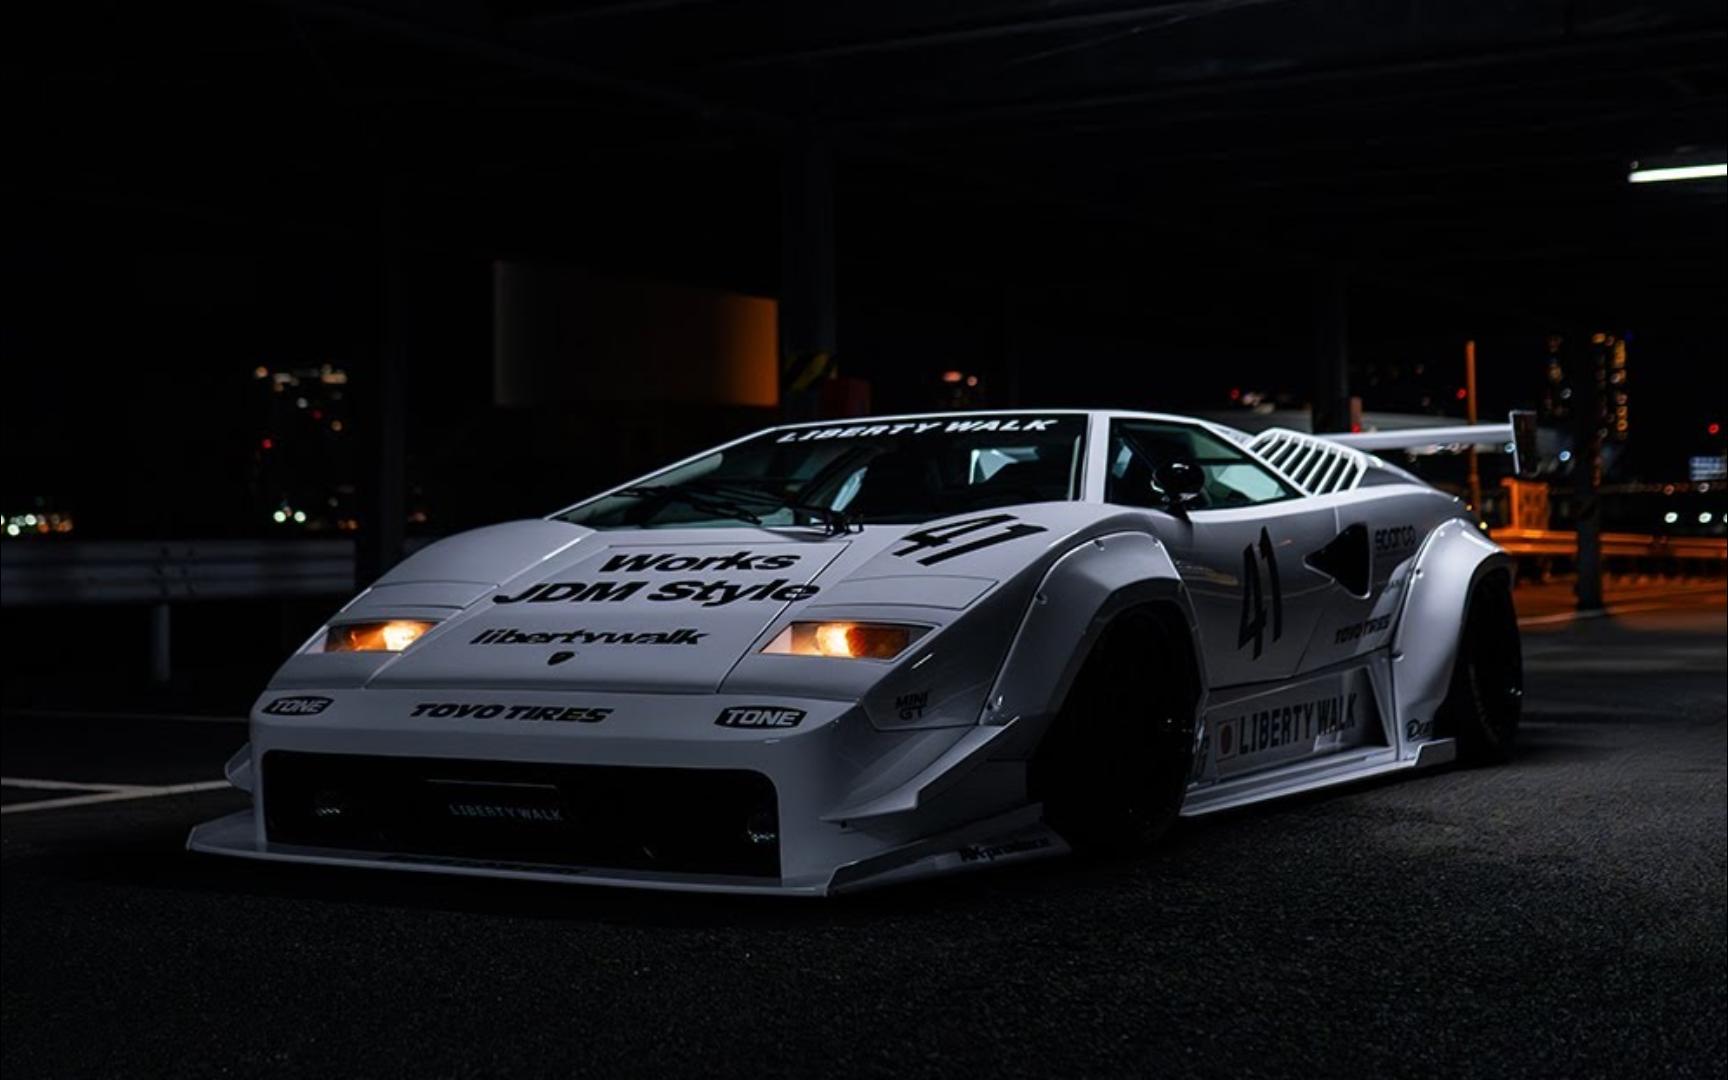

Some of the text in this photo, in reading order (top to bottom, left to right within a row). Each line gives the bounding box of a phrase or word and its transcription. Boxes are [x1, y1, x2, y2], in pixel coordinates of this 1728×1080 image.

[776, 418, 1059, 444] LIBERTY WALK
[893, 514, 1048, 566] 41
[599, 551, 801, 573] Works
[493, 579, 821, 607] JDM Style
[1238, 526, 1282, 661] 41
[470, 629, 709, 645] libertywalk
[270, 699, 330, 714] TONE
[410, 703, 614, 723] TOYO TIRES
[899, 704, 928, 720] GT
[726, 709, 798, 728] TONE
[1239, 702, 1315, 755] LIBERTY
[1317, 693, 1358, 736] WALK
